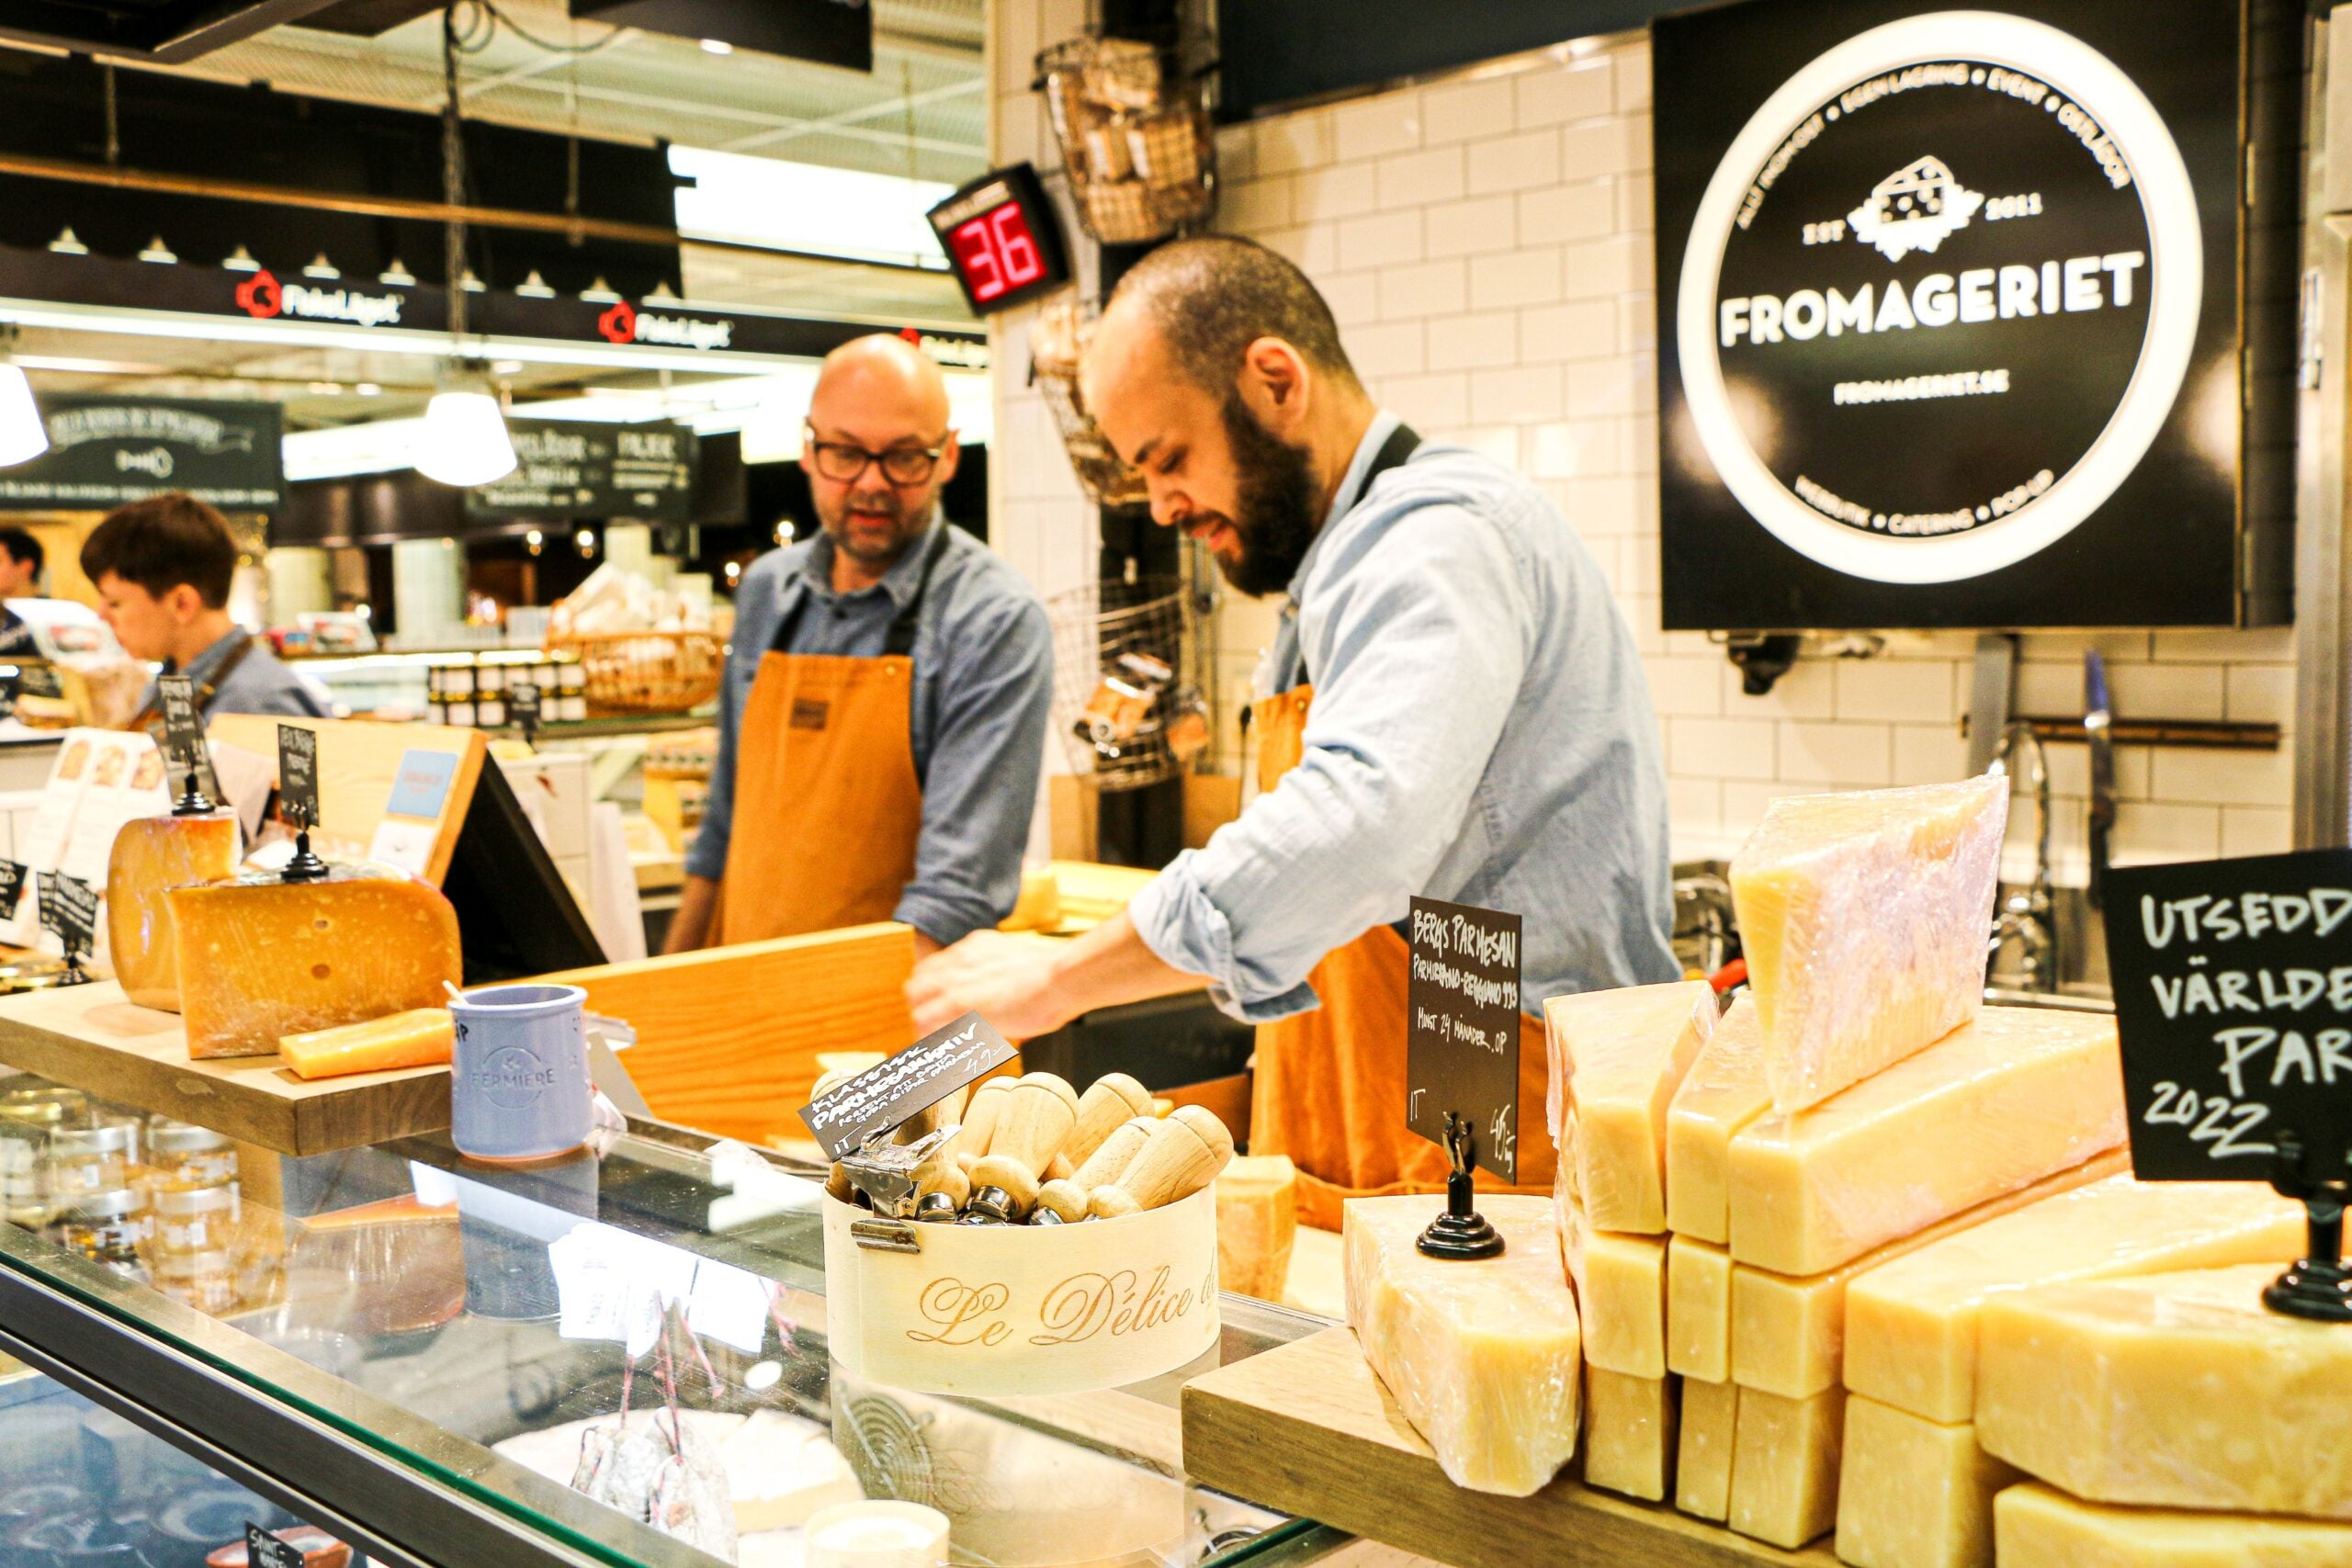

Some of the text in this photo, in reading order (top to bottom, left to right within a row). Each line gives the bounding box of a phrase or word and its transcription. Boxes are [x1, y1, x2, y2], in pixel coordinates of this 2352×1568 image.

[1987, 67, 2049, 106] EVENT
[1803, 192, 2043, 246] EST 2011
[958, 200, 1041, 300] 36
[1720, 251, 2145, 347] FROMAGERIET
[1834, 368, 2010, 405] FROMAGERIET.SE
[1888, 507, 1975, 535] CATERING
[1413, 909, 1516, 968] BERGS PARMESAN
[2141, 887, 2352, 949] UTSEDD
[1440, 1013, 1451, 1043] 24
[812, 1021, 978, 1131] PARMESANKNIV
[812, 1046, 928, 1112] KLASSISK
[2212, 1026, 2352, 1099] PAR
[1410, 1088, 1426, 1122] IT
[2143, 1080, 2278, 1159] 2022
[833, 1125, 863, 1155] IT
[906, 1277, 1014, 1347] Le
[1028, 1264, 1194, 1347] Délice
